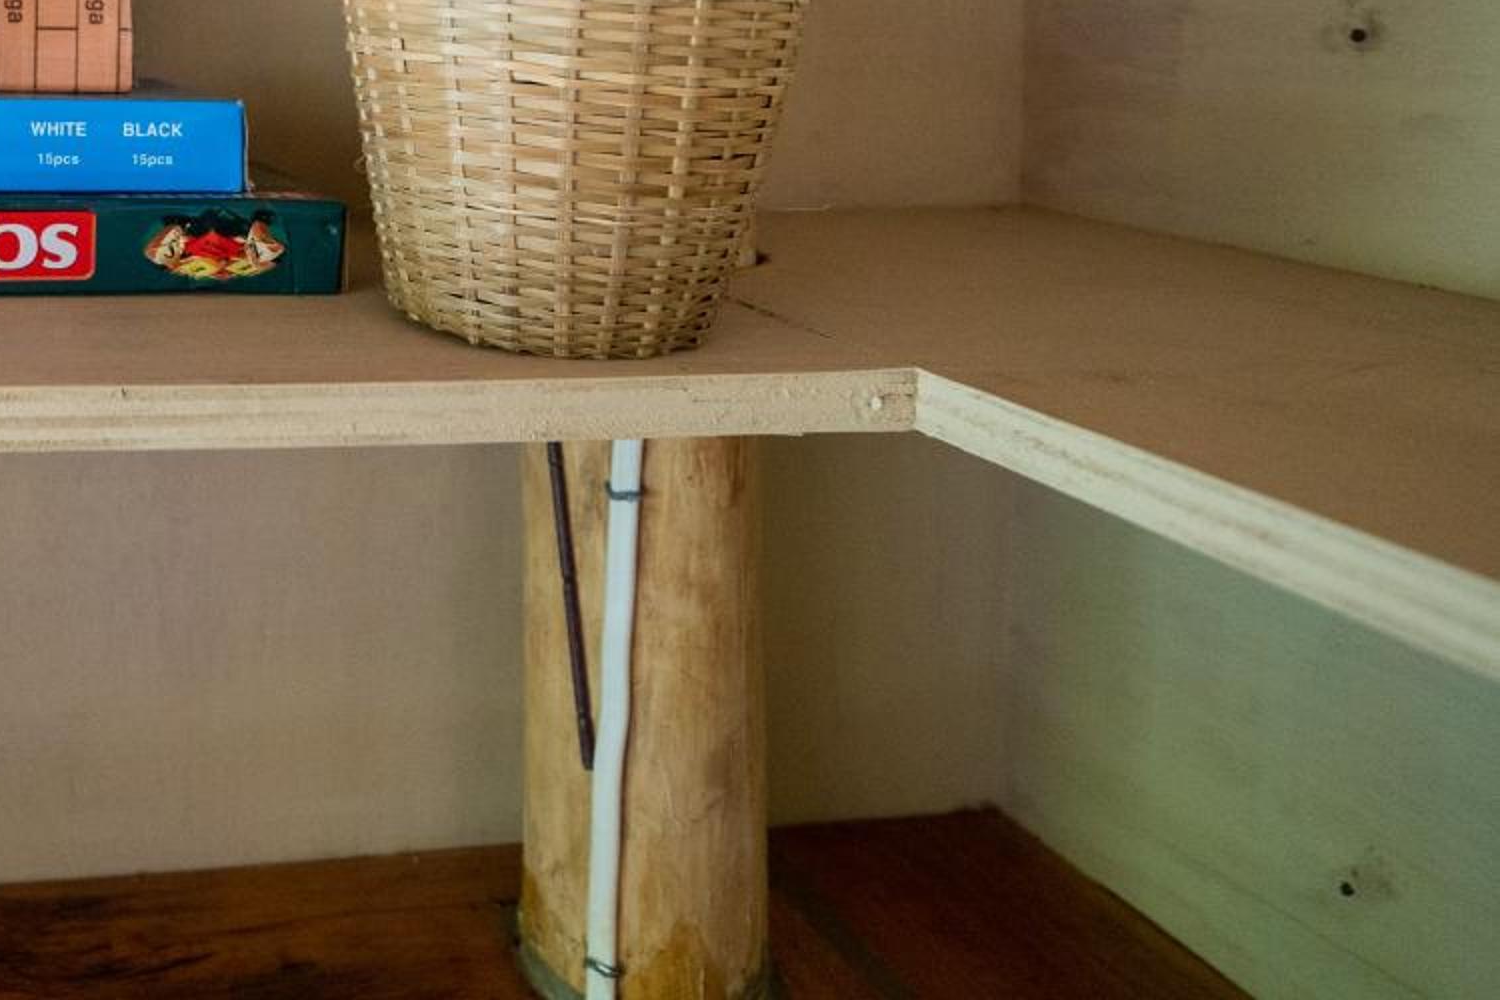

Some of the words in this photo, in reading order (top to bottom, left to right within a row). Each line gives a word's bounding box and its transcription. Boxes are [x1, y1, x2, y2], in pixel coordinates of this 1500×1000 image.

[30, 121, 88, 137] WHITE
[122, 121, 183, 137] BLACK
[37, 152, 80, 168] 15pcs
[131, 152, 174, 168] 15pcs
